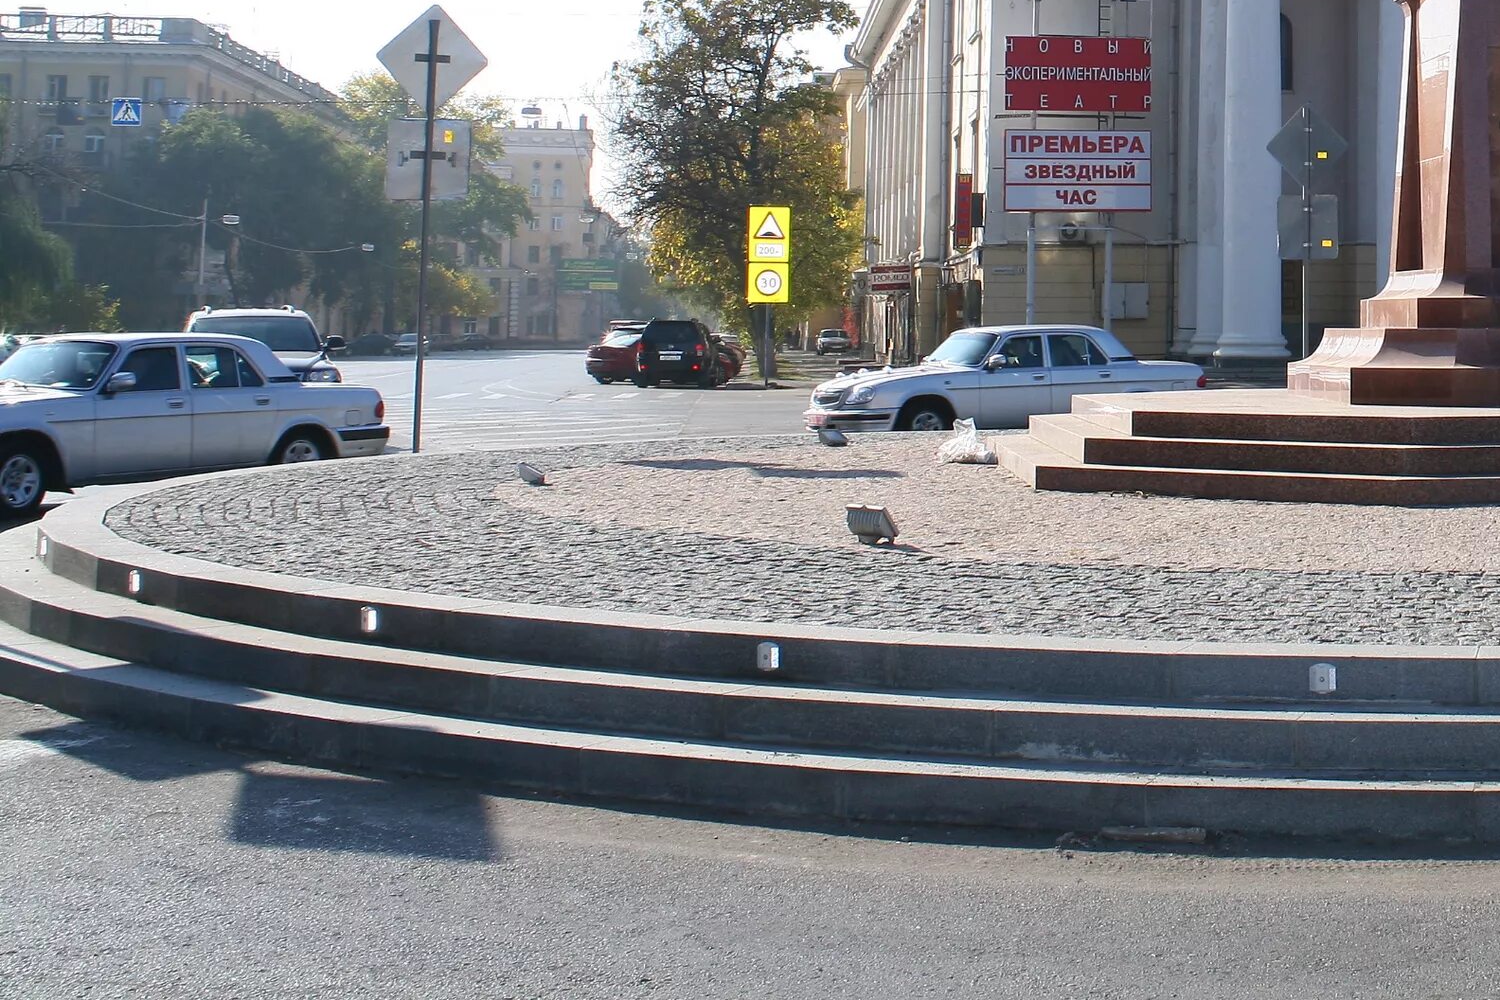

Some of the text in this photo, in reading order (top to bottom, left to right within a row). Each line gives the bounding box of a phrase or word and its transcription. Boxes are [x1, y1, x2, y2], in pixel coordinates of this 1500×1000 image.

[1005, 39, 1152, 54] НОВЫЙ
[1005, 66, 1152, 81] ЭКСПЕРИМЕНТАЛЬНЫЙ
[1005, 94, 1152, 109] ТЕАТР
[1010, 135, 1145, 154] ПРЕМЬЕРА
[1024, 162, 1136, 181] ЗВЁЗДНЫЙ
[1056, 189, 1097, 205] ЧАС
[760, 277, 777, 289] 30
